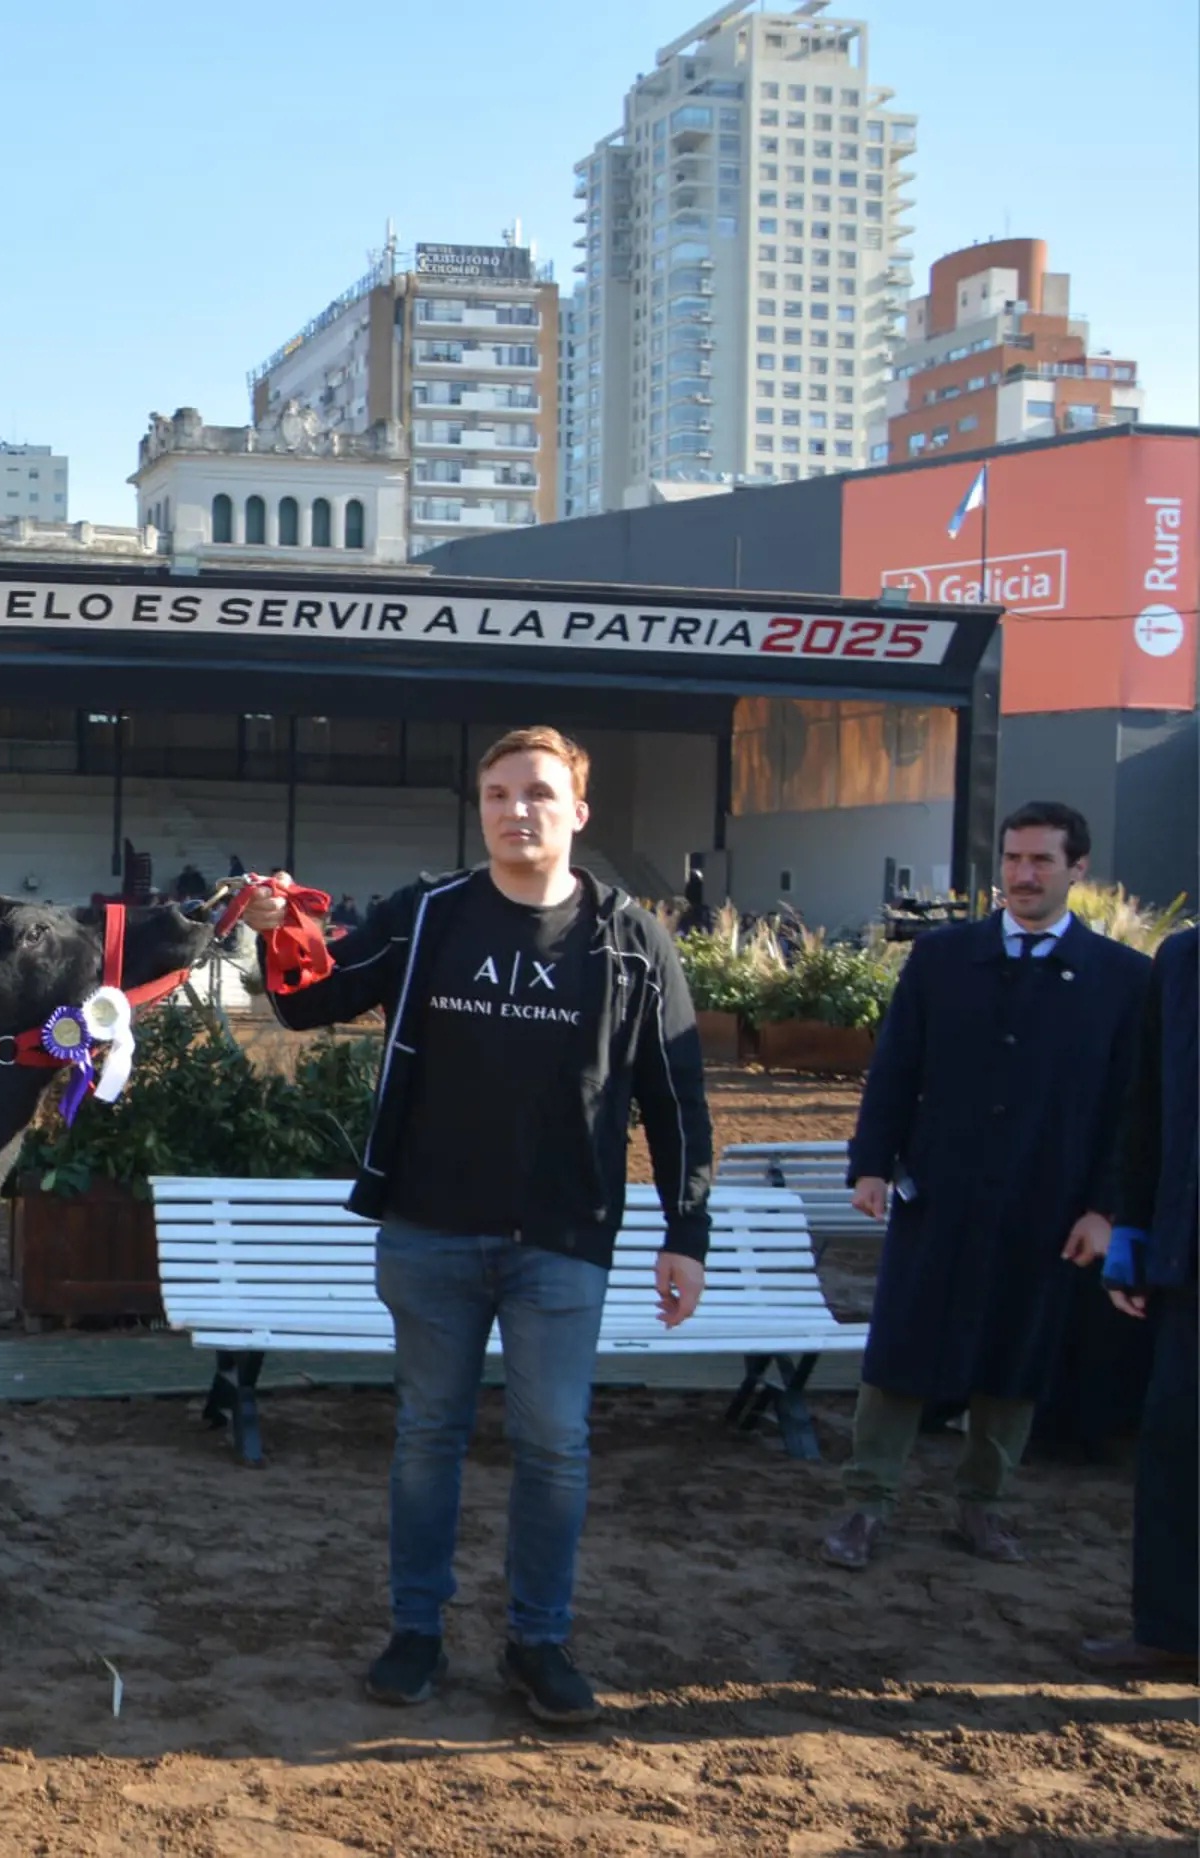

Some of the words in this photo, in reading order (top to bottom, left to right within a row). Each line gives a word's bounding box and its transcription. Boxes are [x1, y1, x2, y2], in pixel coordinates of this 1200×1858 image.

[1144, 497, 1182, 591] Rural
[938, 563, 1052, 605] Galicia
[131, 594, 203, 624] ES
[216, 597, 409, 632] SERVIR
[422, 605, 459, 635] A
[476, 607, 545, 639] LA
[561, 611, 753, 649] PATRIA
[759, 616, 929, 659] 2025
[430, 996, 492, 1015] ARMANI
